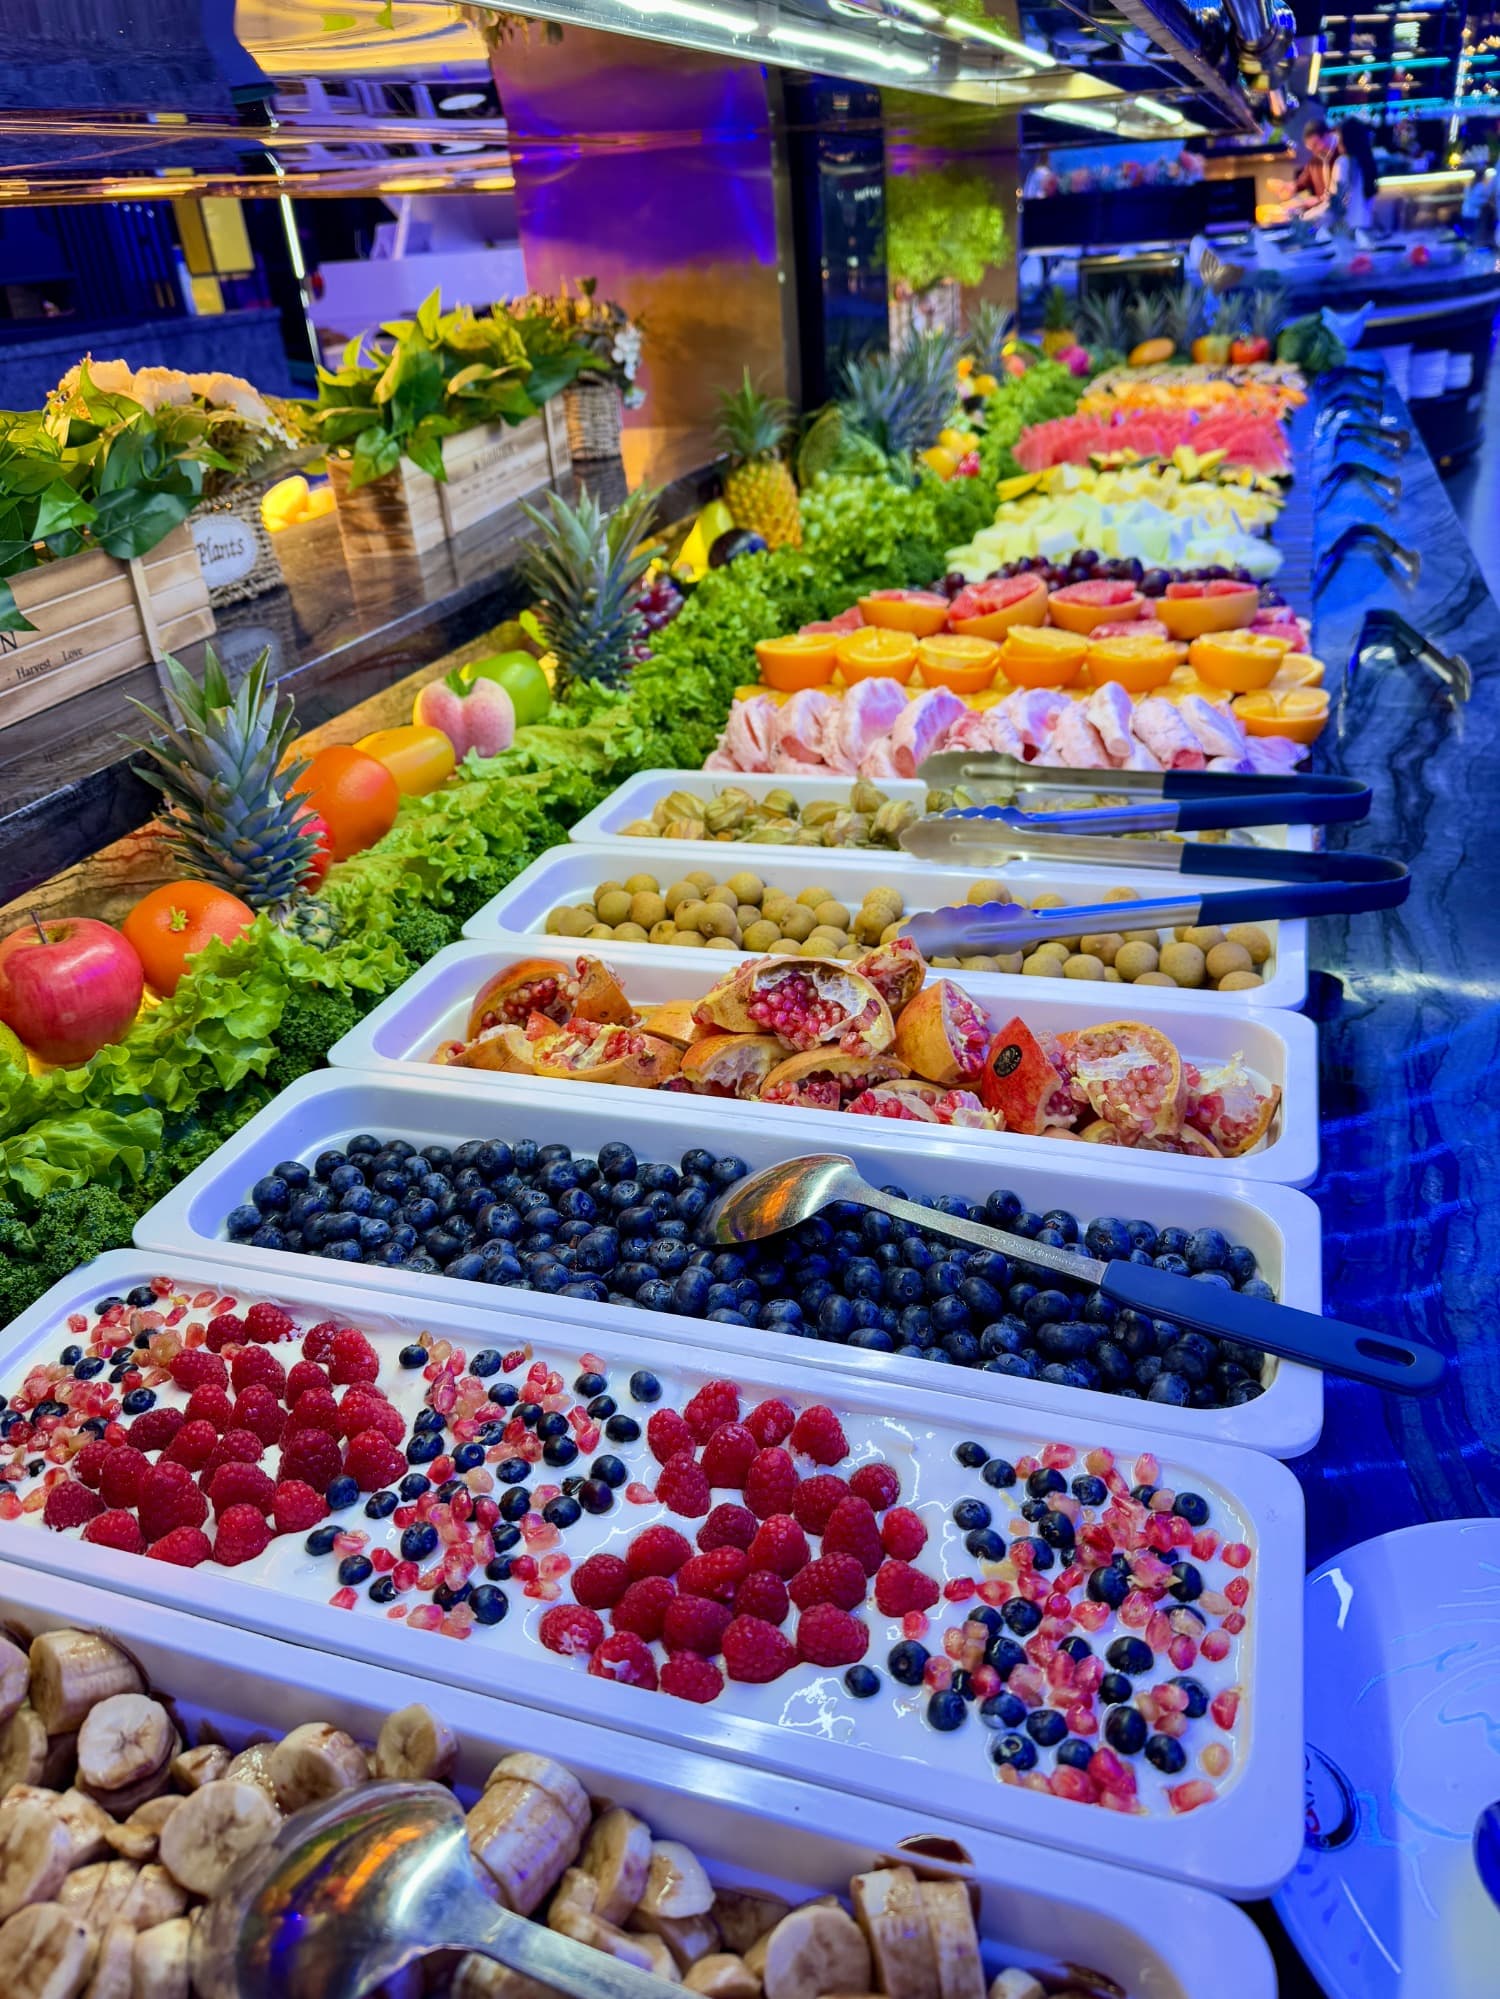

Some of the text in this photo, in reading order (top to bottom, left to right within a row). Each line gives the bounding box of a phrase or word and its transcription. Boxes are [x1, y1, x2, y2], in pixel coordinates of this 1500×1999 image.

[196, 536, 245, 566] Plants
[15, 647, 84, 680] Harvest Love
